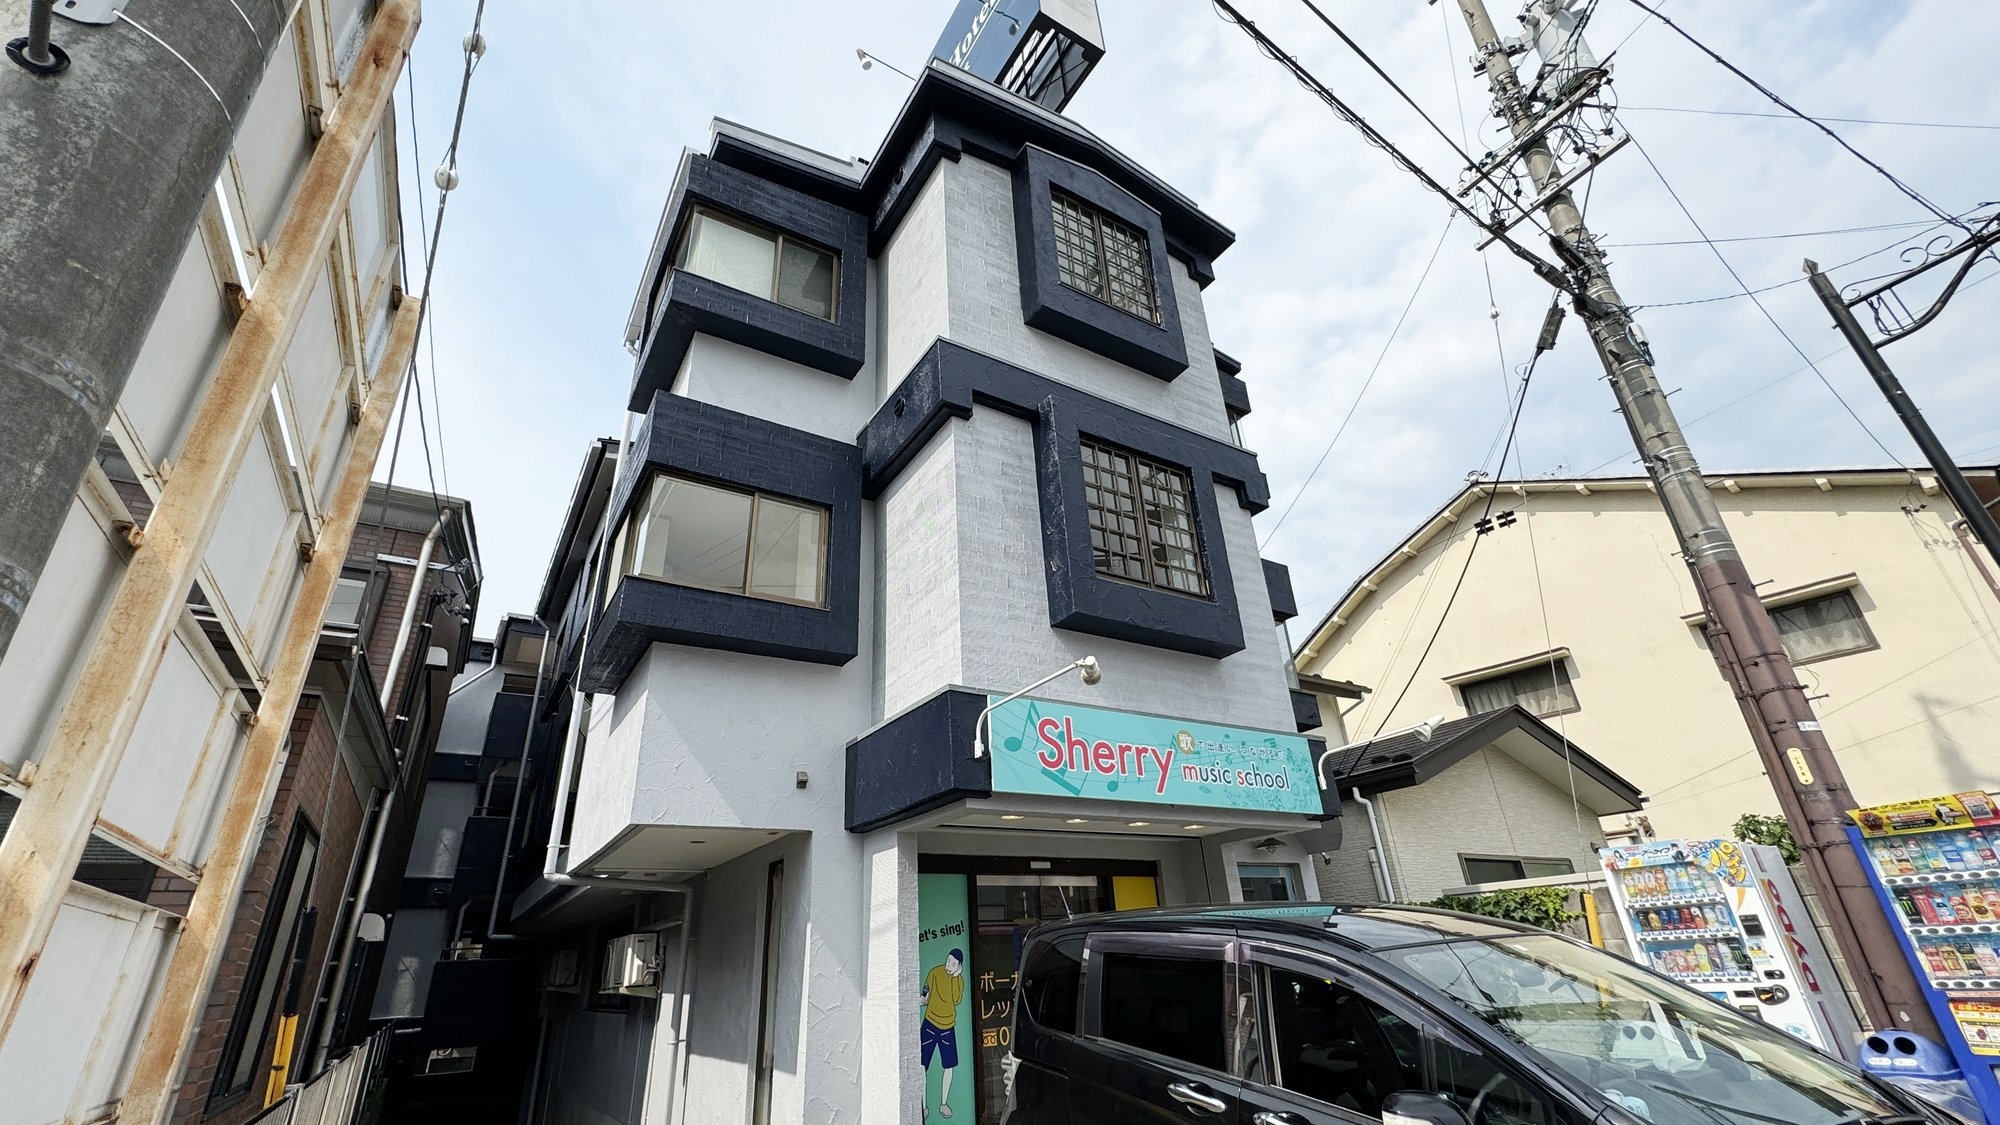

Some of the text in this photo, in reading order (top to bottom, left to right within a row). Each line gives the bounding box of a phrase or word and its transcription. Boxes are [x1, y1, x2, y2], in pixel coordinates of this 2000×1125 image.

[1037, 715, 1174, 795] Sherry
[1181, 761, 1291, 790] music school
[919, 920, 965, 943] et's sing!
[1766, 878, 1821, 994] DyDo
